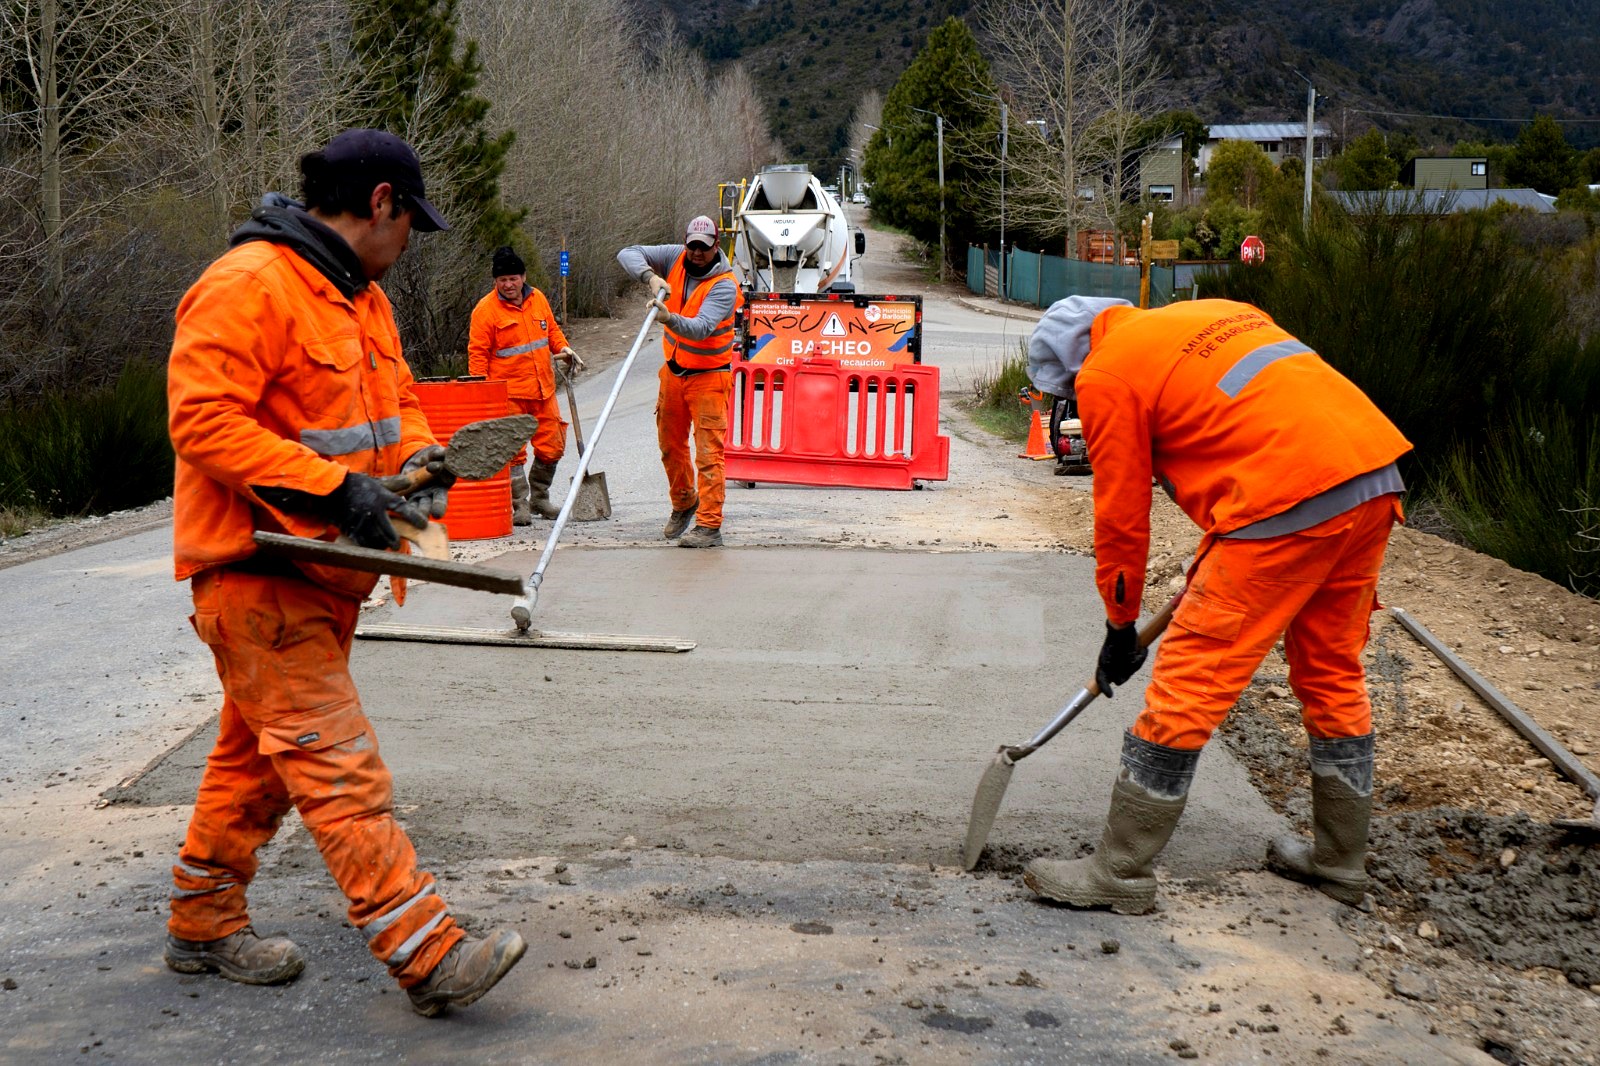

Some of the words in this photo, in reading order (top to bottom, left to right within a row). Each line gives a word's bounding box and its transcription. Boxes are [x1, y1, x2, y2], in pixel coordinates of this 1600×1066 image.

[791, 339, 872, 355] BACHEO
[1182, 313, 1262, 354] MUNICIPALIDAD
[1198, 342, 1219, 359] DE
[1215, 320, 1273, 344] BARILOCHE
[776, 357, 795, 366] Circ
[840, 358, 886, 367] recaución
